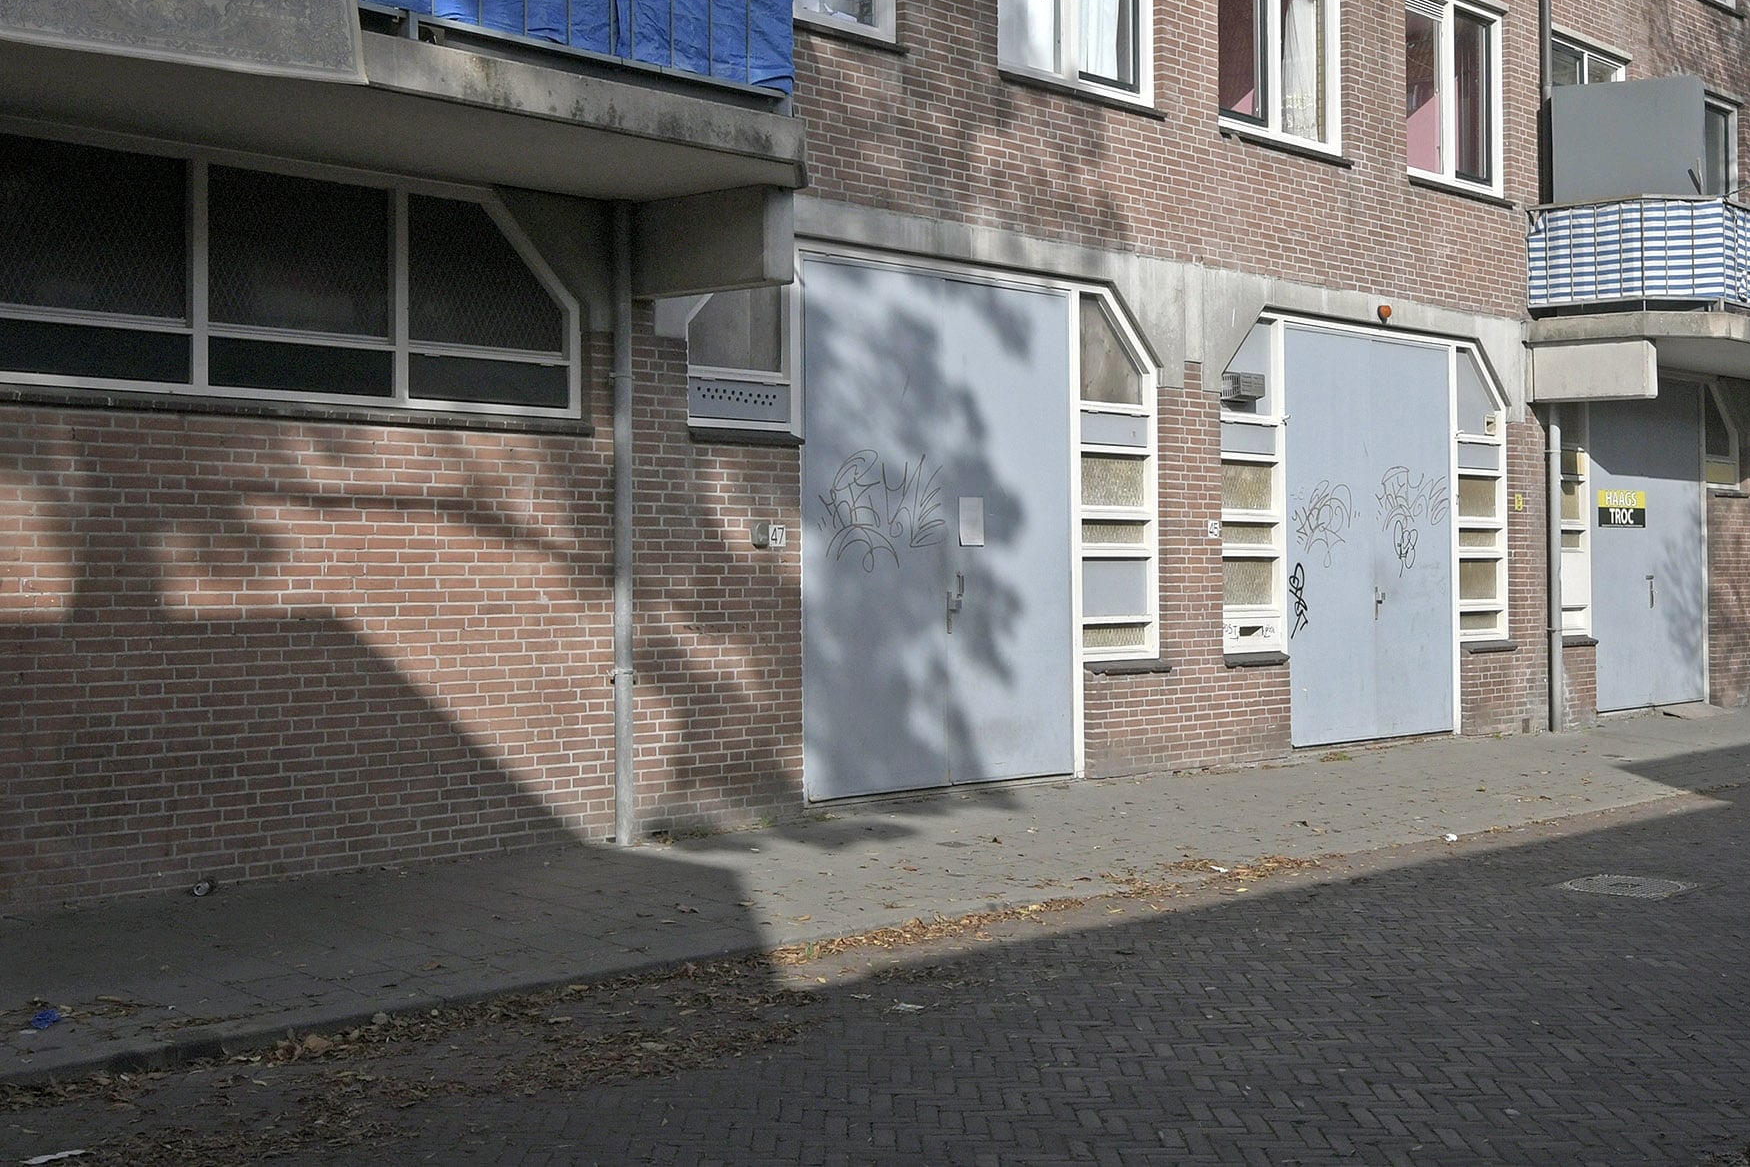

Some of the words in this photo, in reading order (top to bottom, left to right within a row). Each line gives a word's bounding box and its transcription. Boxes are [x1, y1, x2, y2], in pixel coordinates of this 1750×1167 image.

[1605, 490, 1637, 507] HAAGS
[1609, 508, 1634, 524] TROC
[771, 527, 784, 544] 47
[1209, 522, 1218, 537] 45
